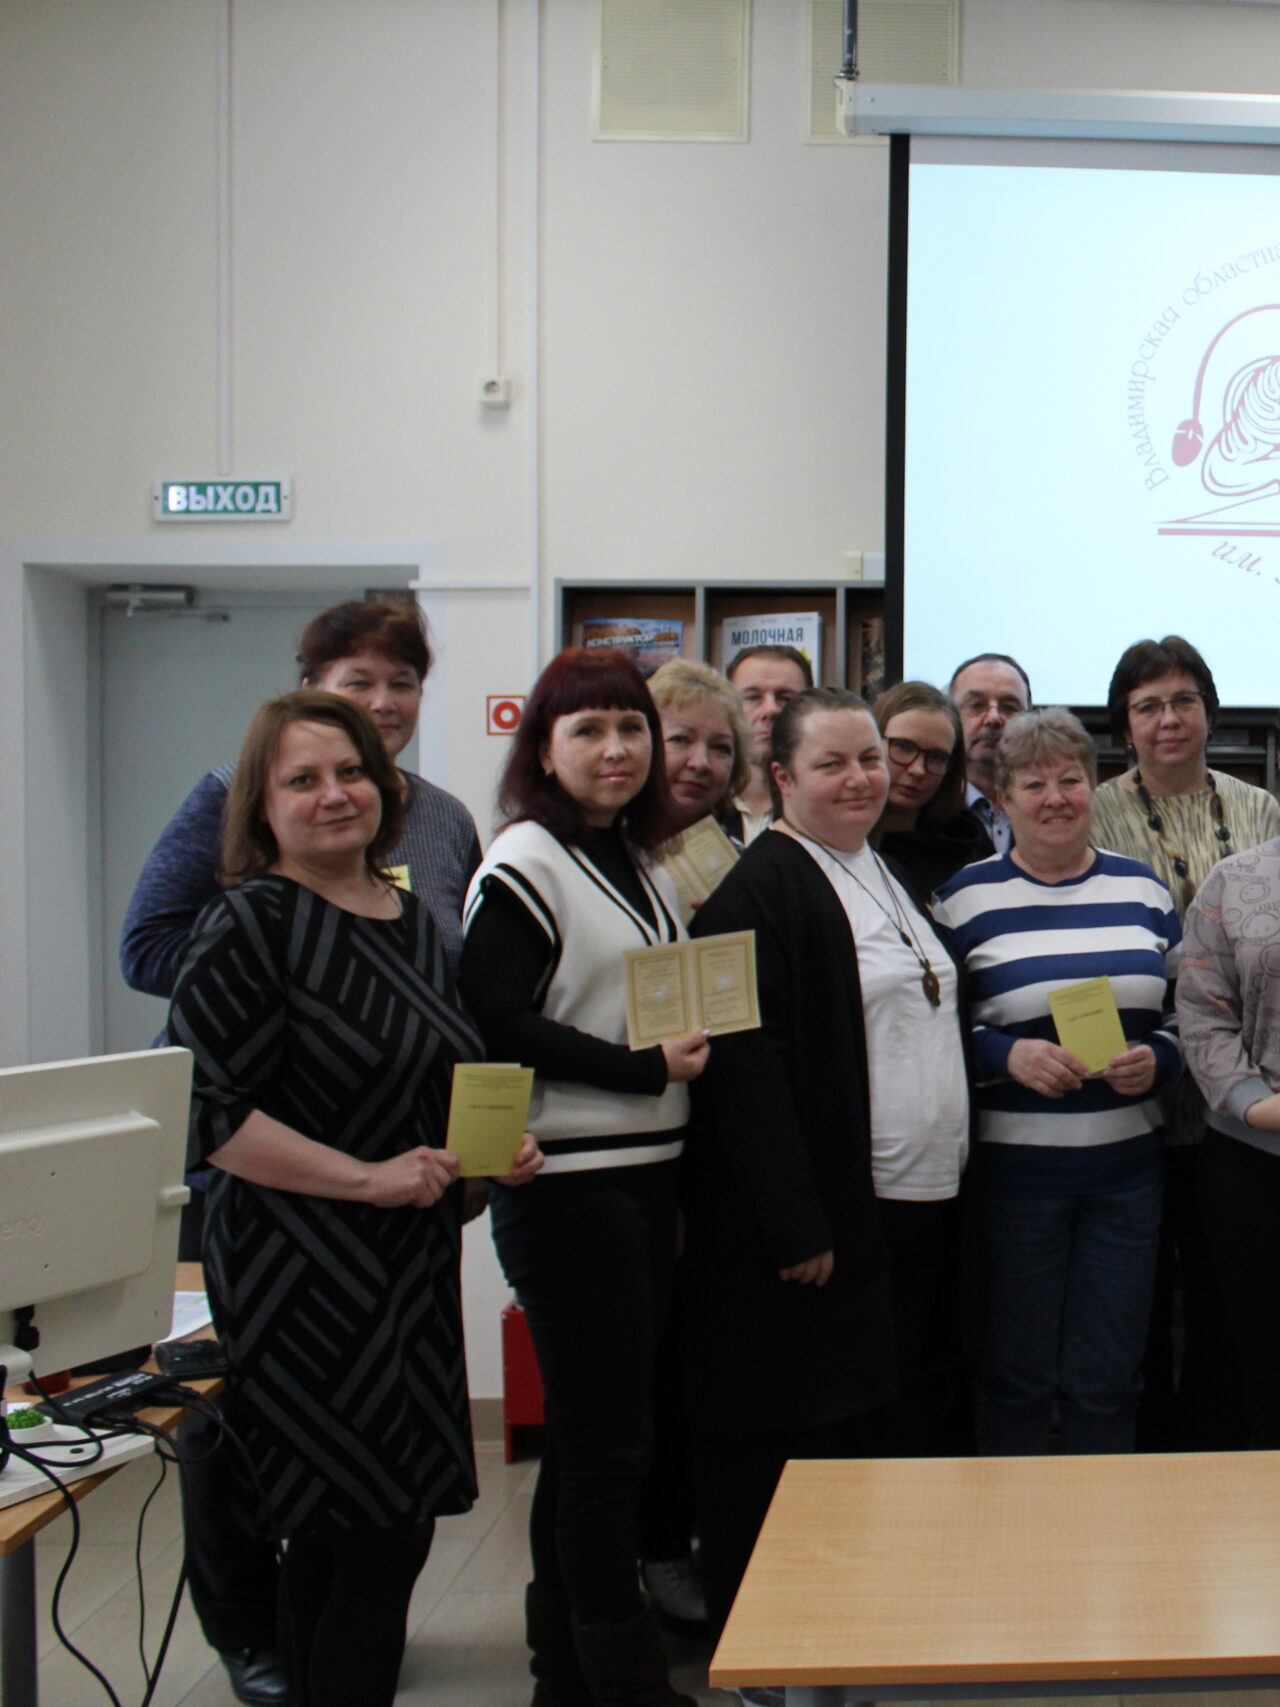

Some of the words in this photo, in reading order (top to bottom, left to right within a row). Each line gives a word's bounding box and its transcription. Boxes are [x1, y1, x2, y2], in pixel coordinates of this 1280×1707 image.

[1127, 306, 1181, 491] Владимирская
[167, 485, 279, 512] ВЫХОД
[1211, 540, 1262, 577] им.
[731, 627, 804, 646] МОЛОЧНАЯ
